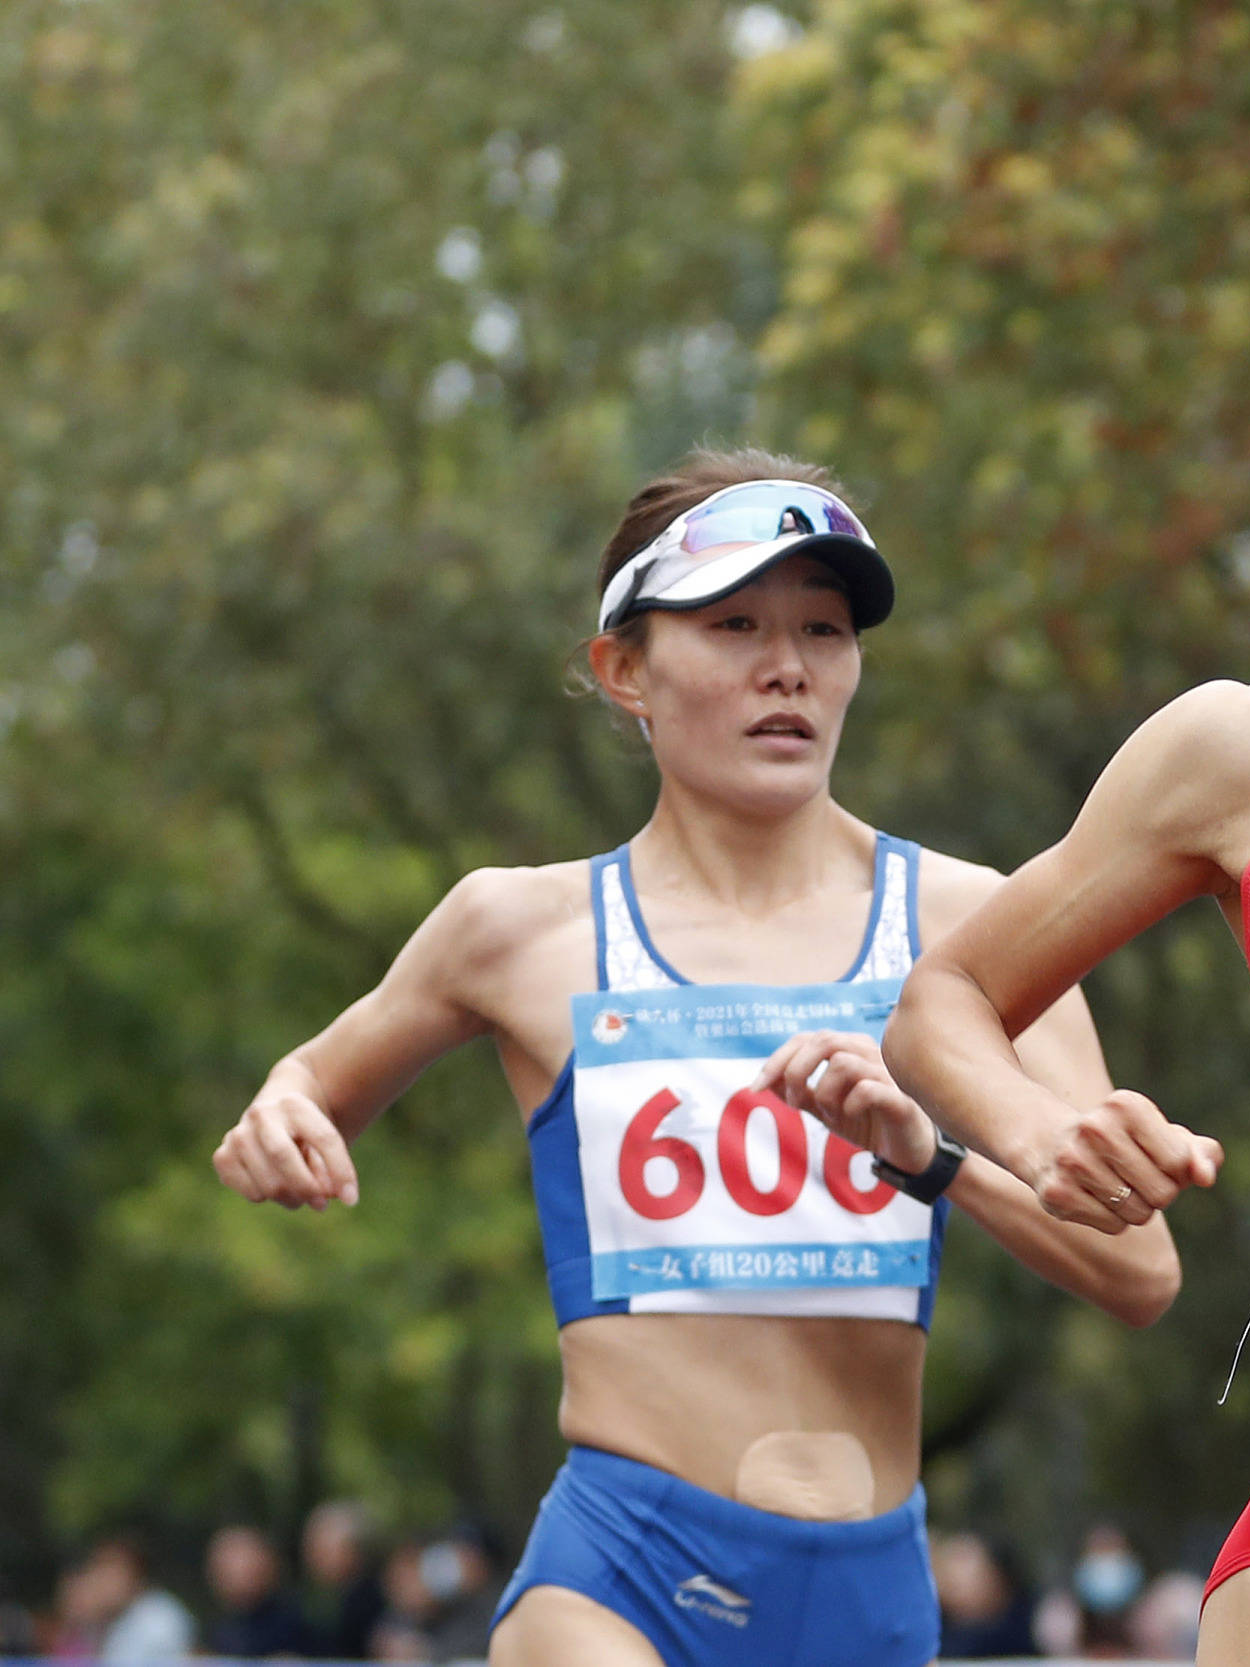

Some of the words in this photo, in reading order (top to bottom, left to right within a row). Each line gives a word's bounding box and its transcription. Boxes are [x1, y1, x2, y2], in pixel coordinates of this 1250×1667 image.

[618, 1086, 899, 1220] 606
[660, 1249, 880, 1281] 女子组20公里竞走
